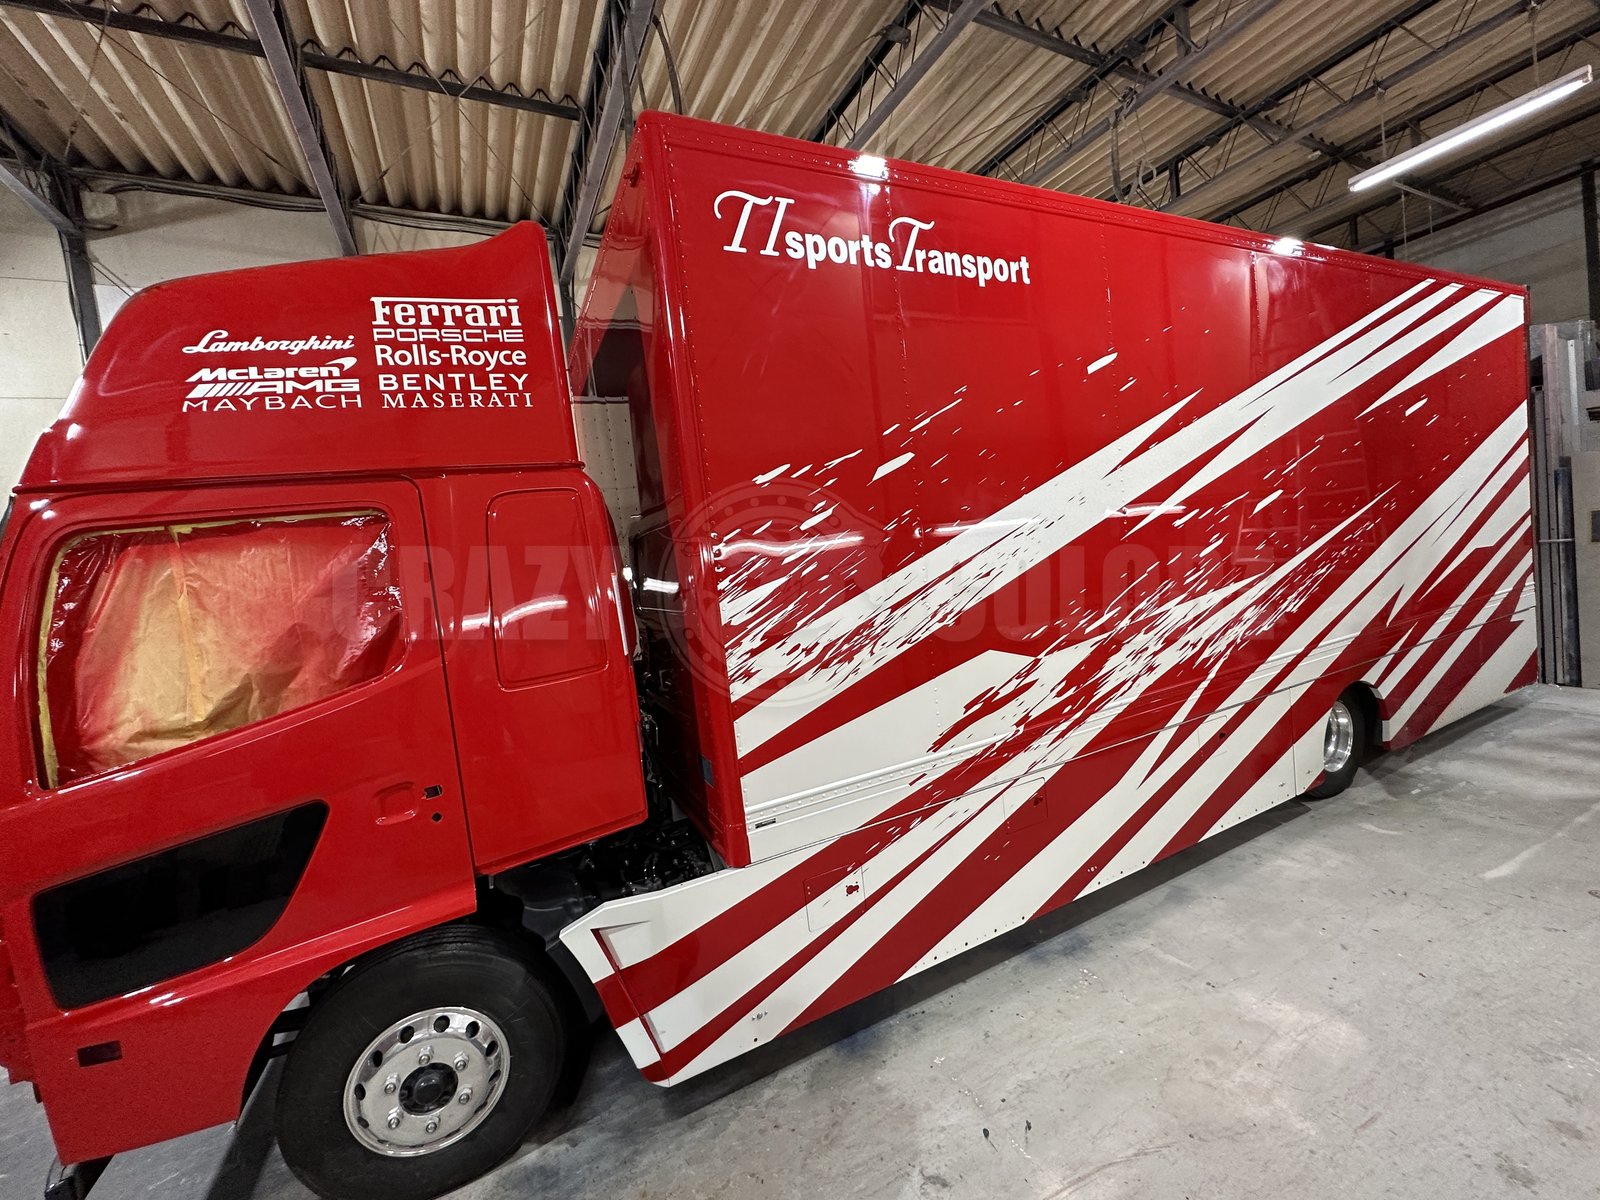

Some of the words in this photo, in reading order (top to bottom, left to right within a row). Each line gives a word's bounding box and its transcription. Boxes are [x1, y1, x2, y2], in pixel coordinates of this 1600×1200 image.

[369, 296, 522, 326] Ferrari
[181, 329, 355, 356] Lamborghini
[372, 328, 525, 343] PORSCHE
[374, 343, 527, 372] Rolls-Royce
[185, 364, 342, 383] McLaren
[378, 373, 529, 391] BENTLEY
[182, 394, 363, 413] MAYBACH
[381, 392, 533, 409] MASERATI
